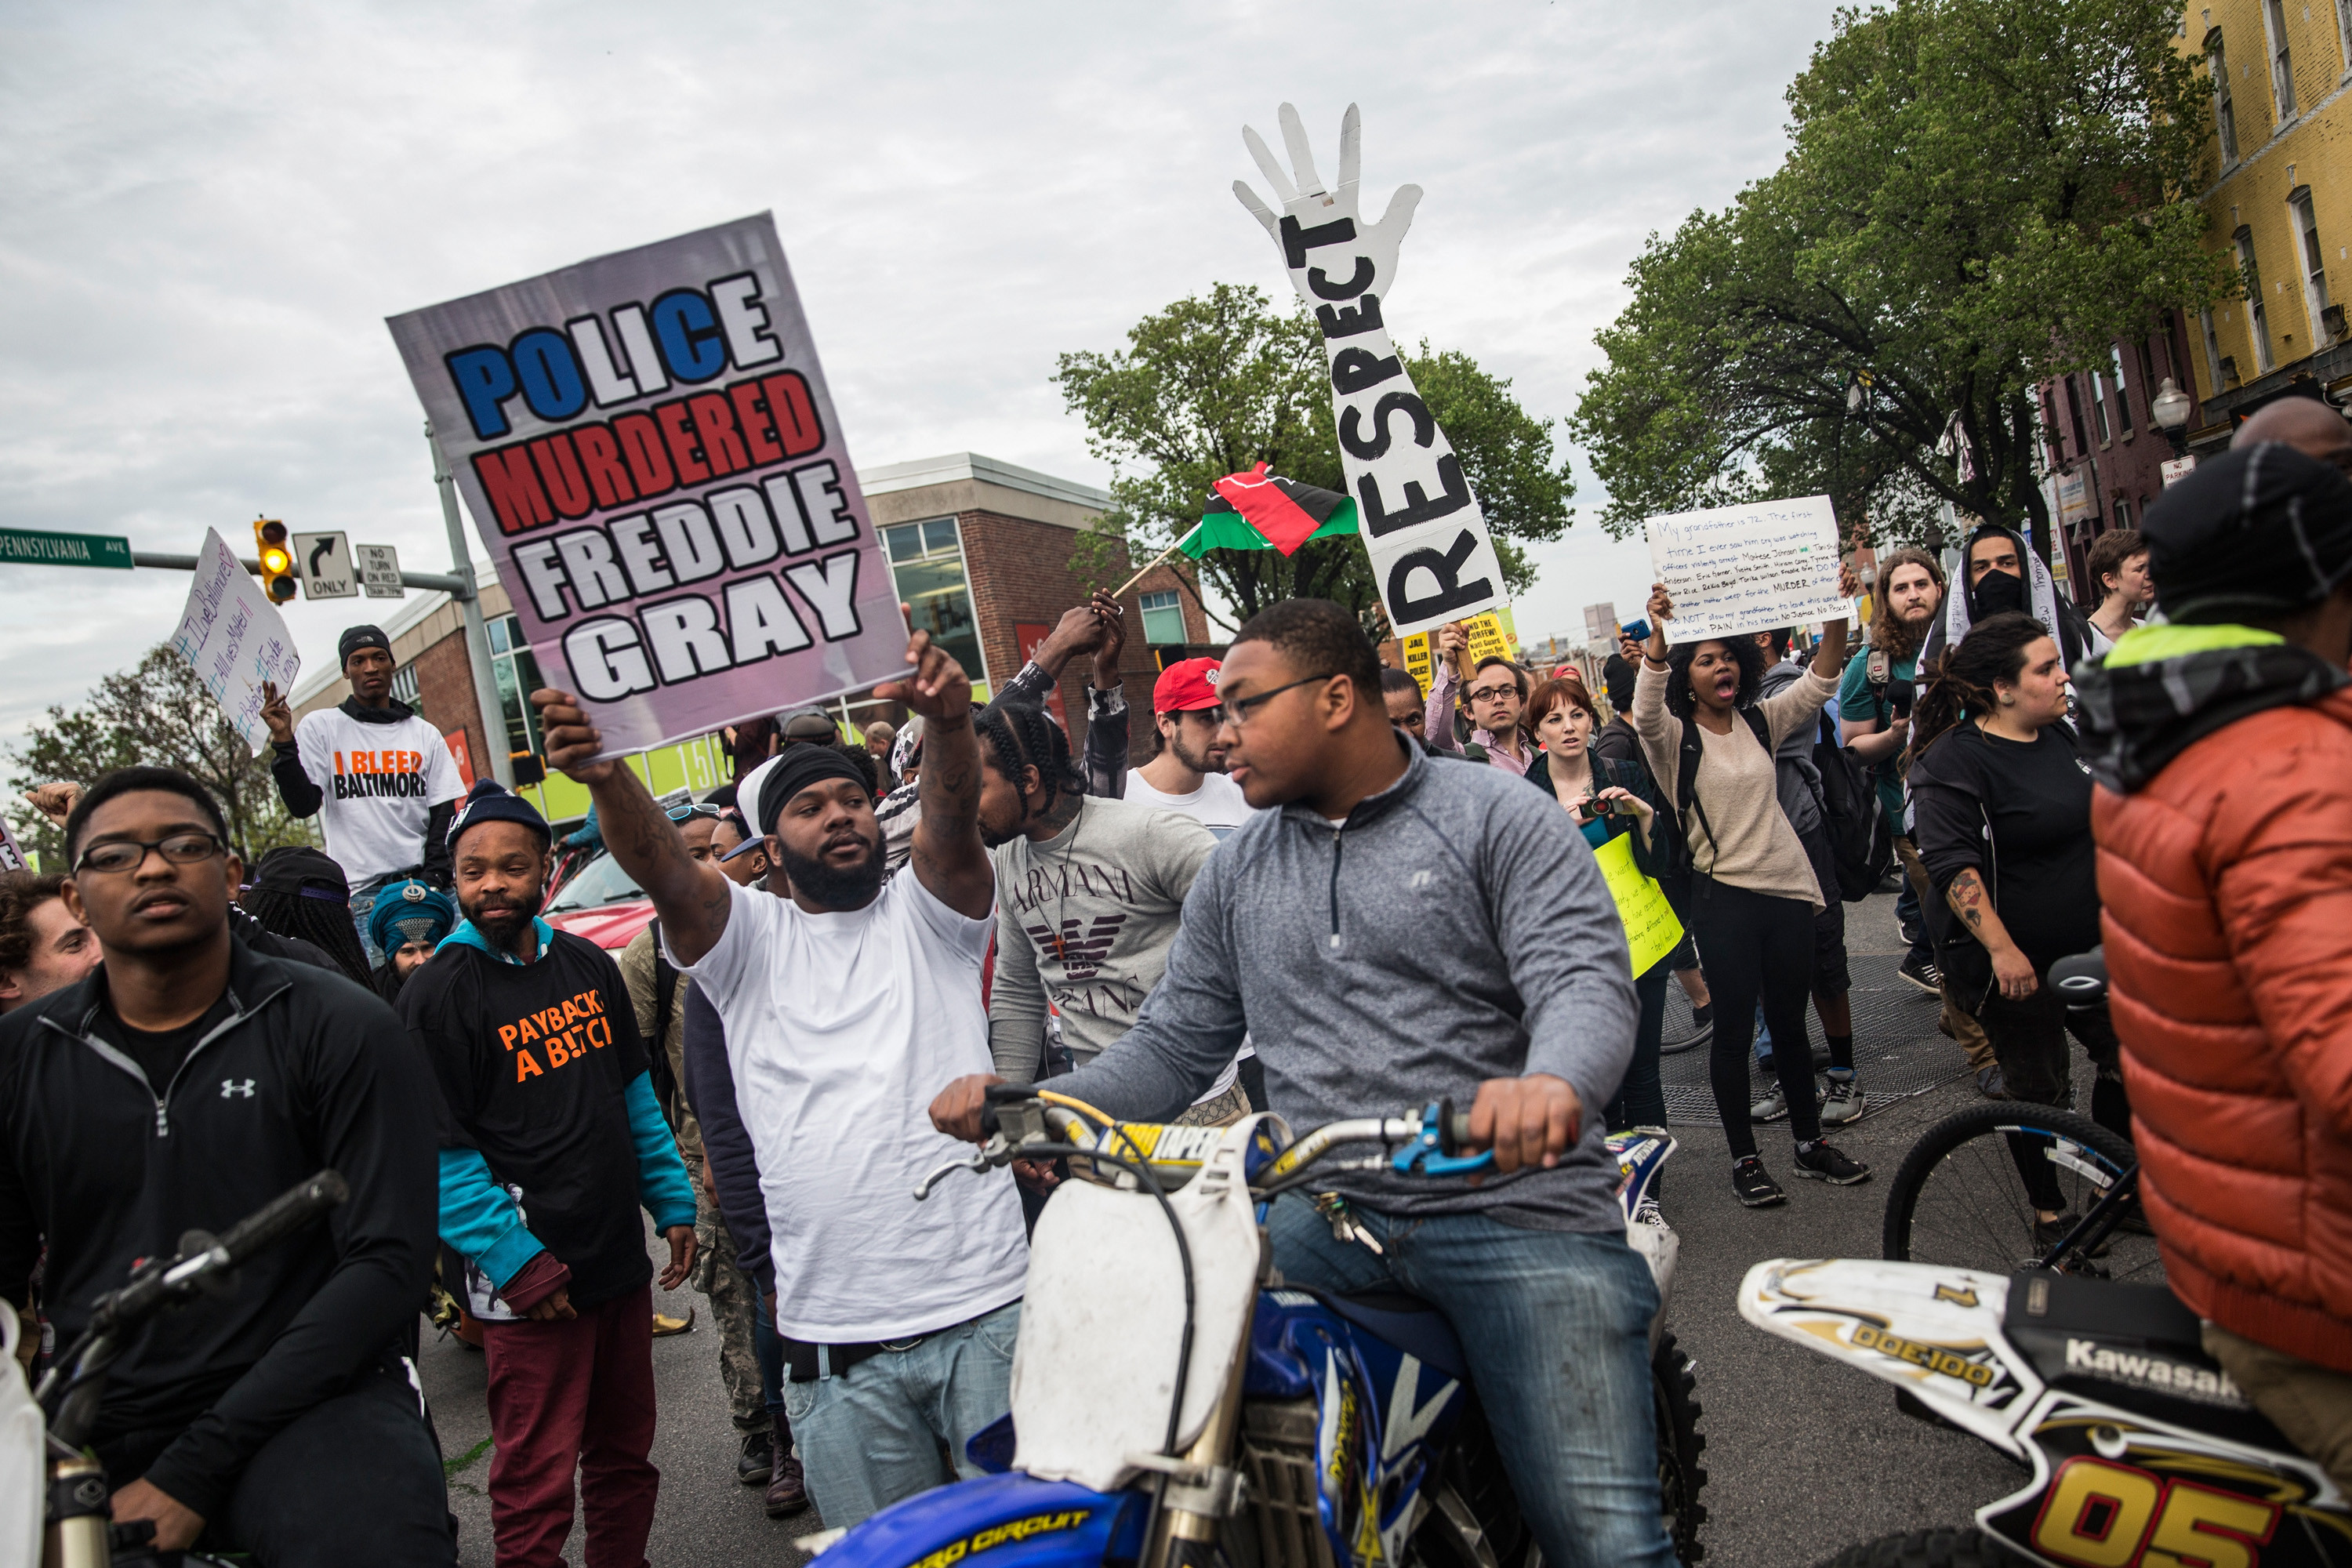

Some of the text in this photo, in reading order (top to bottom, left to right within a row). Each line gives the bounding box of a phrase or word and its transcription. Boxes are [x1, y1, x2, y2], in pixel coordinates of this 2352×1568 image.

[444, 270, 783, 441] POLICE
[1279, 214, 1494, 626] RESPECT
[470, 369, 826, 535] MURDERED
[1657, 521, 1679, 543] My
[1684, 521, 1735, 541] grandfather
[1747, 516, 1766, 524] 72.
[1767, 512, 1788, 521] The
[0, 535, 126, 561] PENNSYLVANIA AVE
[370, 549, 385, 558] NO
[510, 459, 860, 624] FREDDIE
[1667, 547, 1693, 558] time
[1697, 545, 1706, 554] I
[1709, 543, 1727, 552] ever
[1788, 531, 1817, 539] watching
[369, 560, 390, 571] TURN
[1662, 562, 1687, 572] officers
[1691, 559, 1716, 568] violently
[1719, 555, 1738, 564] arrest
[1742, 552, 1771, 561] Martese
[1771, 549, 1797, 557] Johnson
[1697, 572, 1711, 581] Eric
[1733, 565, 1752, 575] Yvette
[1809, 555, 1829, 564] Tyrone
[1831, 561, 1841, 569] NO
[2032, 556, 2045, 591] Thomas
[314, 580, 347, 595] ONLY
[367, 572, 397, 583] ON RED
[1724, 593, 1741, 601] weep
[1773, 579, 1810, 593] MURDER
[1683, 612, 1705, 624] NOT
[1708, 613, 1724, 622] allow
[1726, 612, 1735, 620] my
[1739, 605, 1775, 620] grandfather
[1823, 594, 1838, 603] world
[1709, 621, 1733, 633] PAIN
[1817, 606, 1827, 615] No
[1829, 600, 1853, 614] Peace!
[562, 549, 863, 702] GRAY
[1468, 621, 1479, 631] ND
[1480, 619, 1493, 628] THE
[1409, 638, 1424, 648] JAIL
[1479, 648, 1494, 657] Cops
[1496, 645, 1505, 654] Out
[1483, 637, 1501, 647] Guard
[1407, 652, 1428, 663] KILLER
[1409, 665, 1429, 676] POLICE!
[334, 751, 344, 775] I
[351, 750, 423, 775] BLEED
[334, 771, 426, 800] BALTIMORE
[1615, 858, 1631, 877] want
[1014, 863, 1138, 915] ARMANI
[517, 1048, 544, 1083] A
[2066, 1338, 2242, 1401] Kawasak
[2031, 1454, 2284, 1568] 05
[971, 1510, 1091, 1553] CIRCUIT
